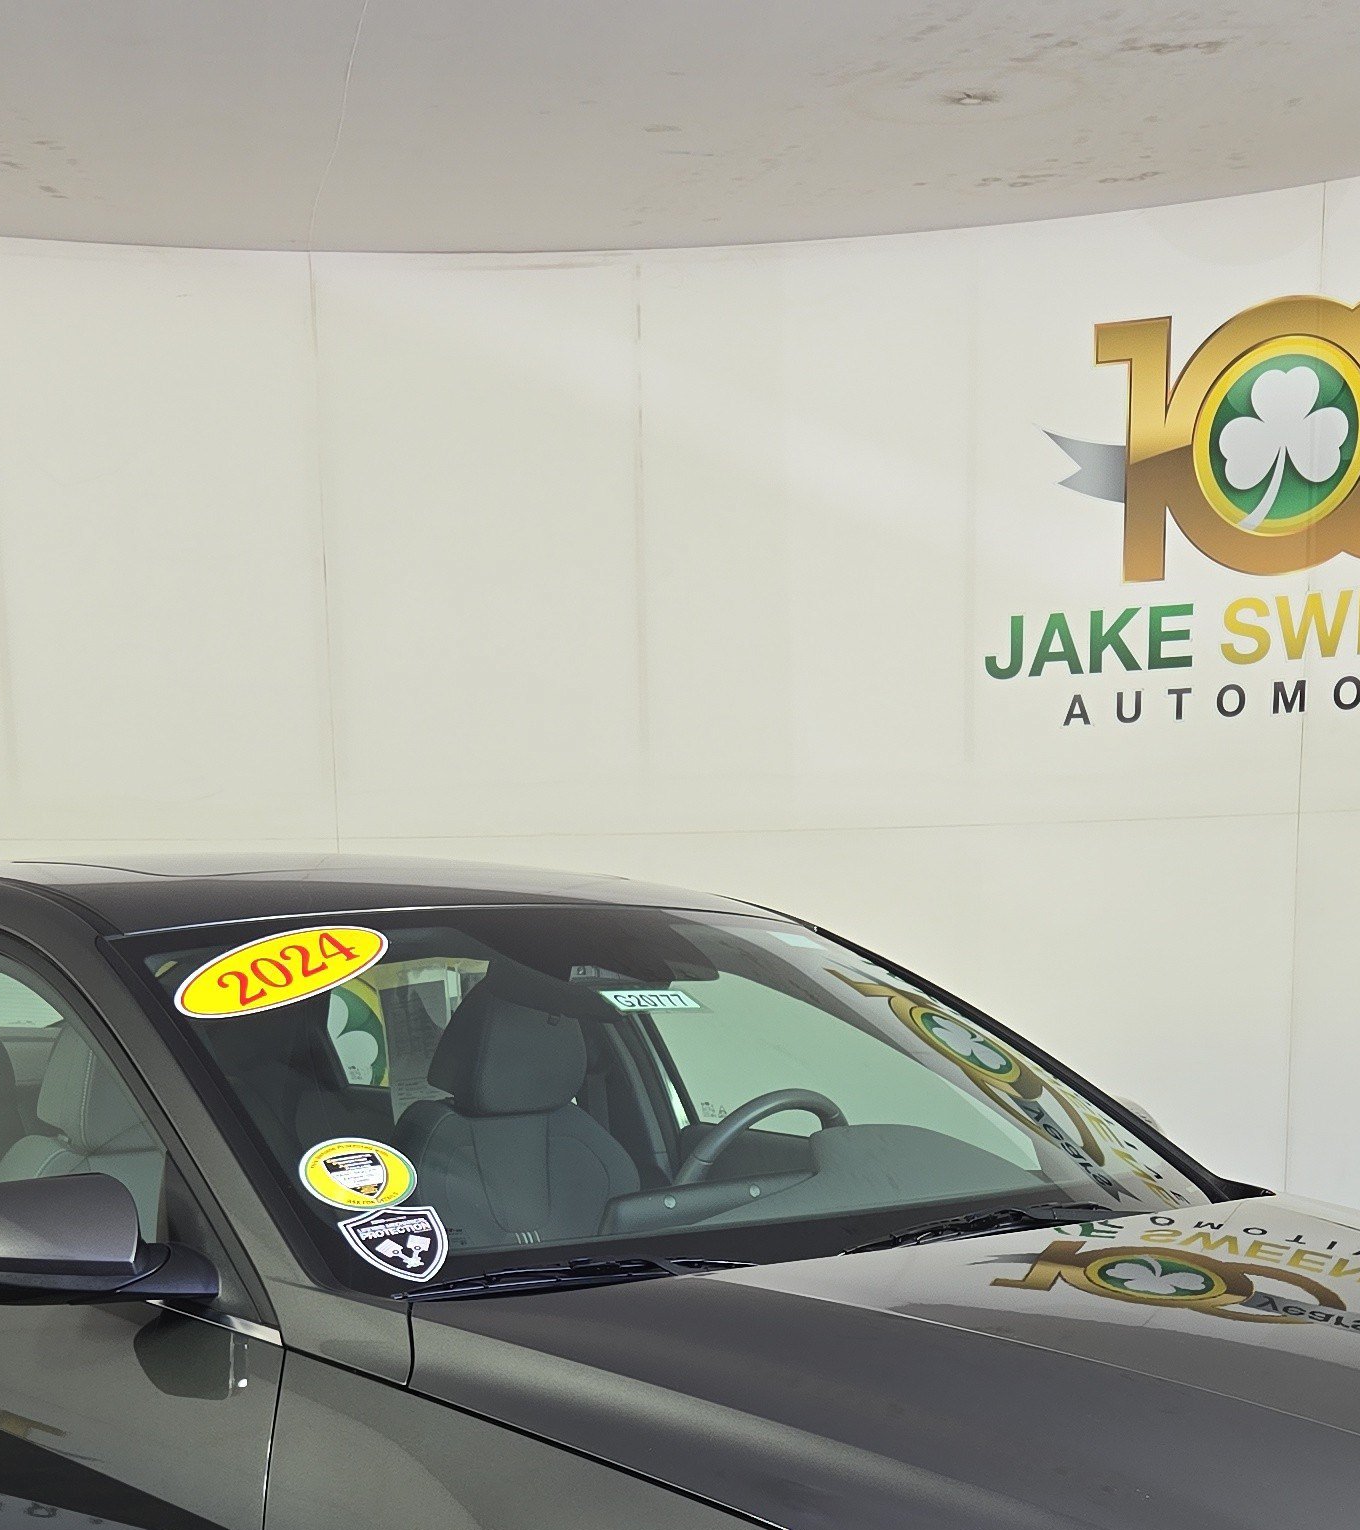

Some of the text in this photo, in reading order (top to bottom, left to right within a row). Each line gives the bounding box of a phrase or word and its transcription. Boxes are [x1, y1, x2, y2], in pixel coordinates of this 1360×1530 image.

[984, 603, 1195, 680] JAKE
[217, 932, 361, 1007] 2024
[614, 993, 689, 1008] G20777
[359, 1222, 432, 1241] PROTECTION
